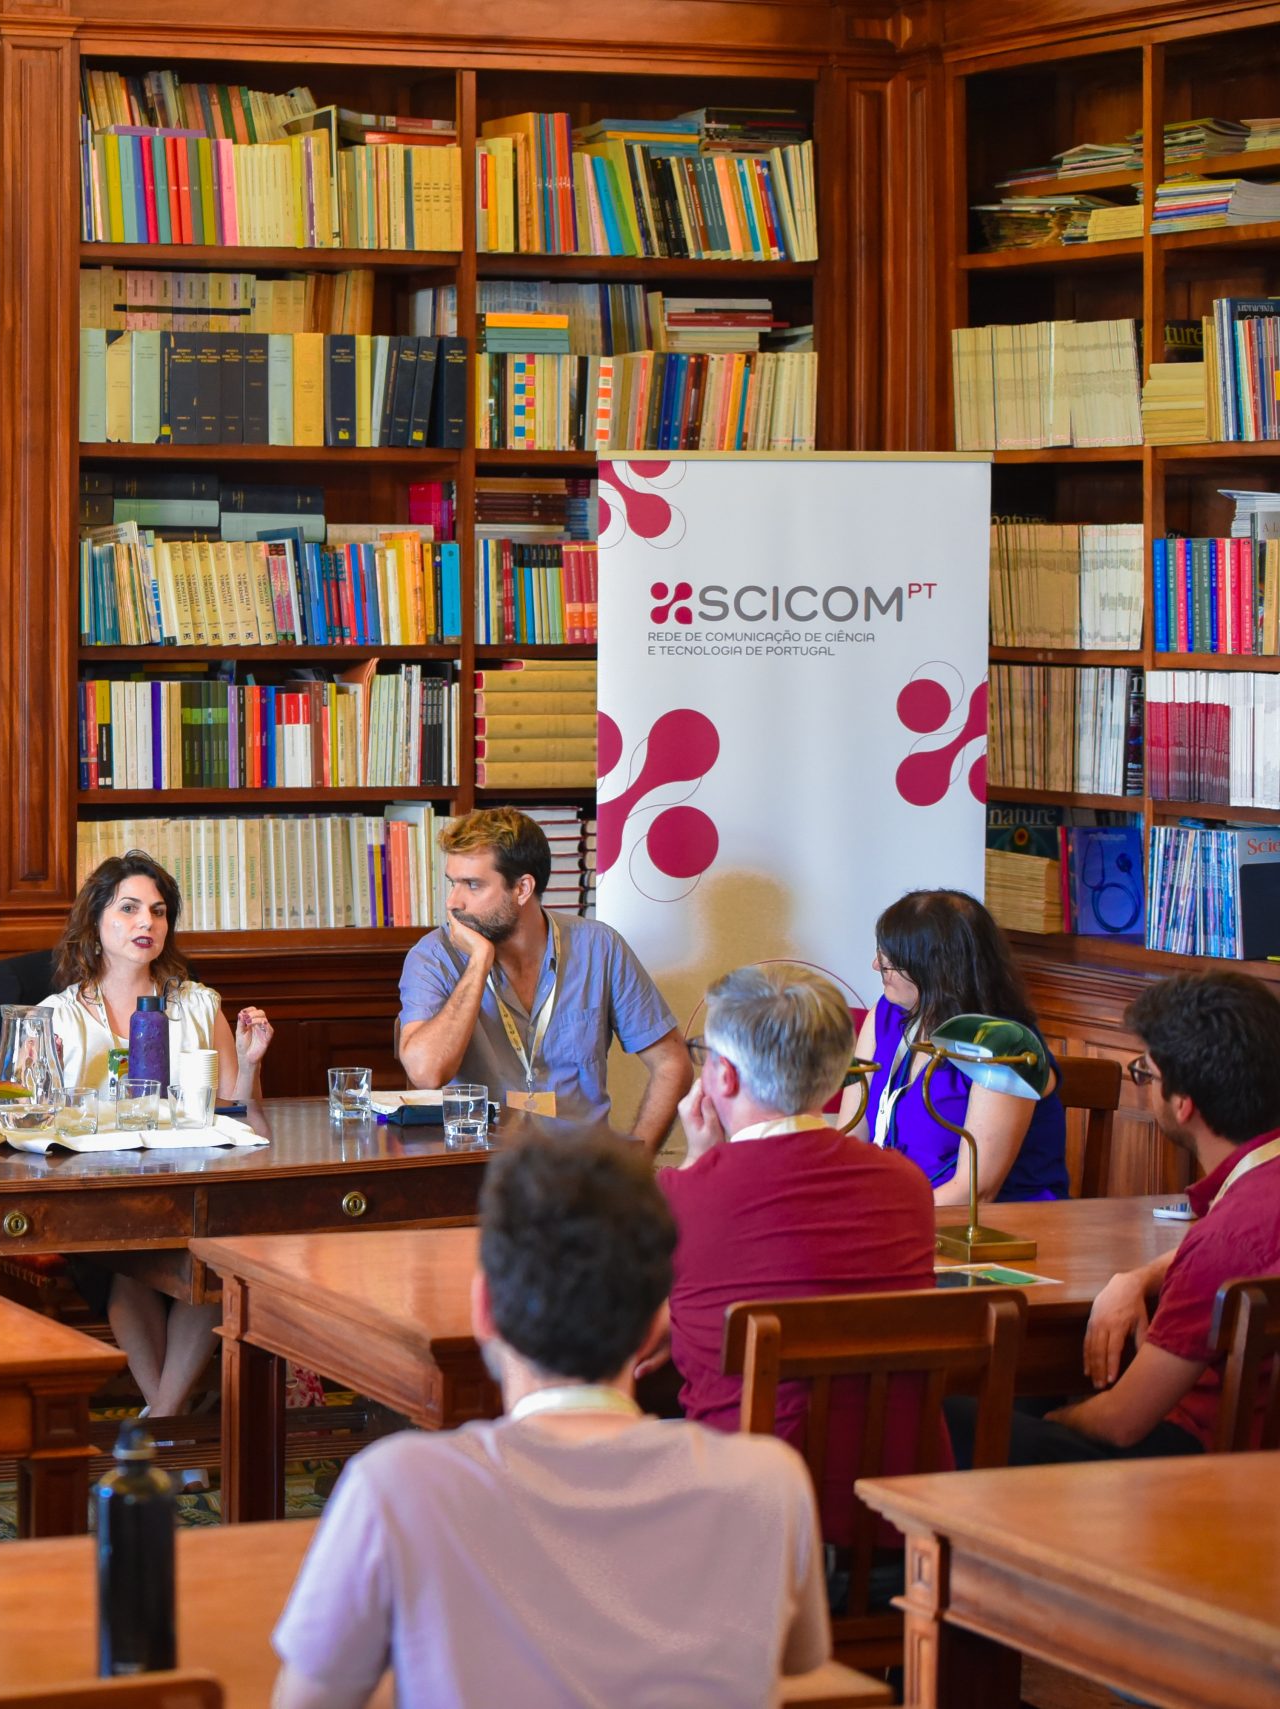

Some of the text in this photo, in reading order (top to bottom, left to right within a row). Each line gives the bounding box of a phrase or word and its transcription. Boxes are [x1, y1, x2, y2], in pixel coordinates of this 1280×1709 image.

[907, 583, 937, 599] PT
[698, 585, 903, 622] SCICOM
[648, 629, 875, 644] REDE DE COMUNICAÇÃO DE CIÊNCIA
[648, 646, 835, 656] E TECNOLOGIA DE PORTUGAL
[988, 807, 1056, 825] nature
